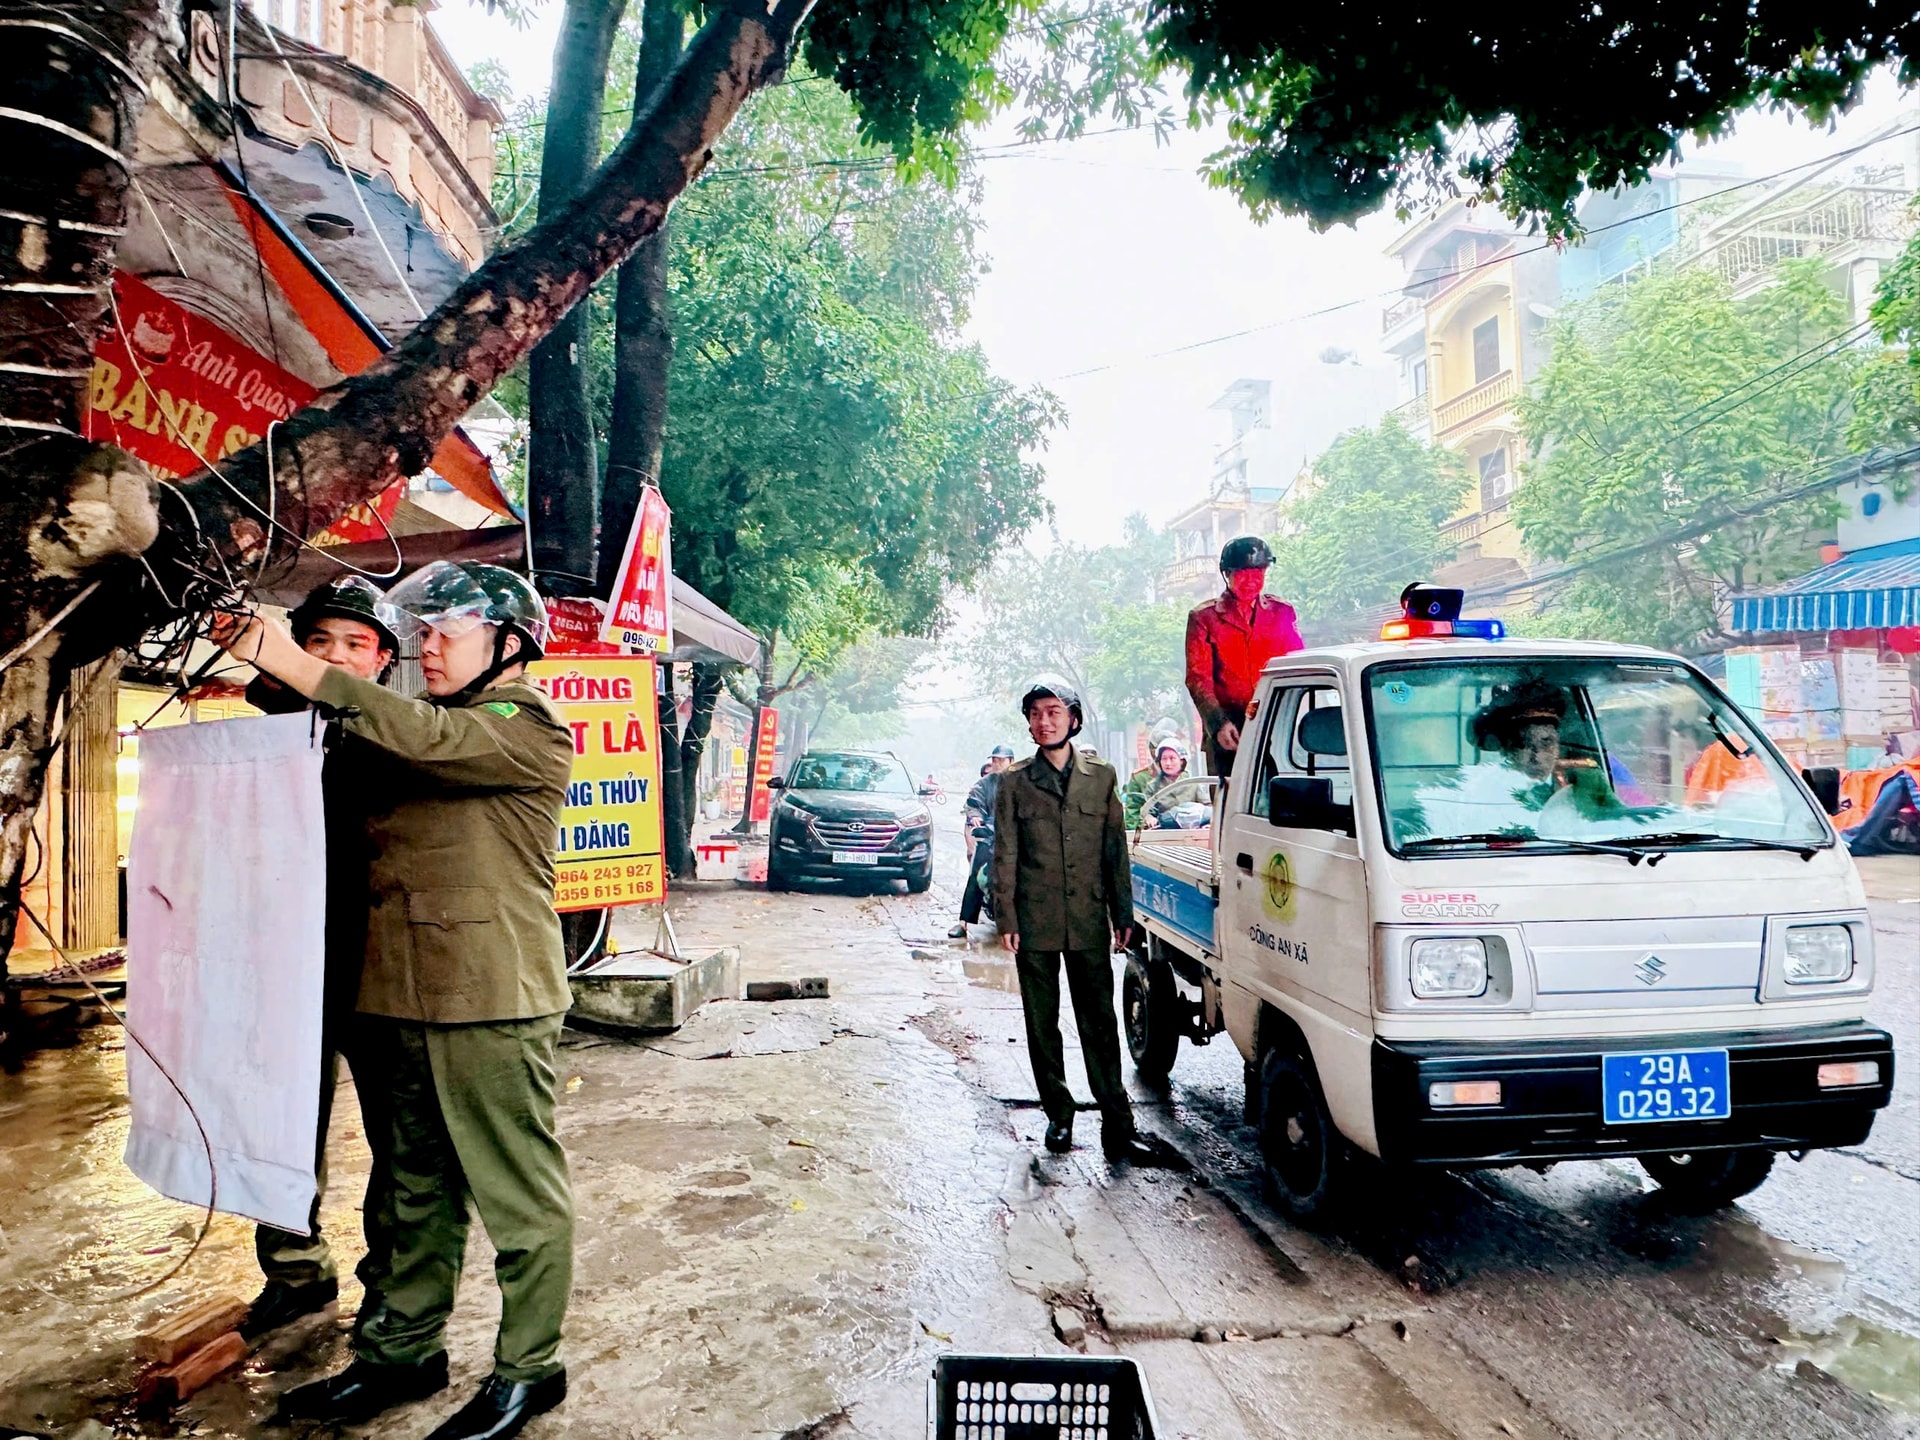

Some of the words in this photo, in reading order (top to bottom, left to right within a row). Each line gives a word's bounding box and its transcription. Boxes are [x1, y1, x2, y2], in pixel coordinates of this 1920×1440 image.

[180, 341, 238, 389] Anh
[91, 356, 218, 458] BÁNH
[602, 713, 647, 754] LÀ
[598, 771, 648, 805] THỦY
[573, 819, 630, 851] ĐĂNG
[593, 867, 622, 881] 243
[626, 863, 653, 878] 927
[594, 883, 622, 899] 615
[627, 881, 654, 895] 168
[1401, 893, 1477, 903] SUPER
[1401, 903, 1500, 918] CARRY
[1277, 936, 1292, 958] AN
[1639, 1055, 1693, 1085] 29A
[1618, 1086, 1716, 1119] 029.32
